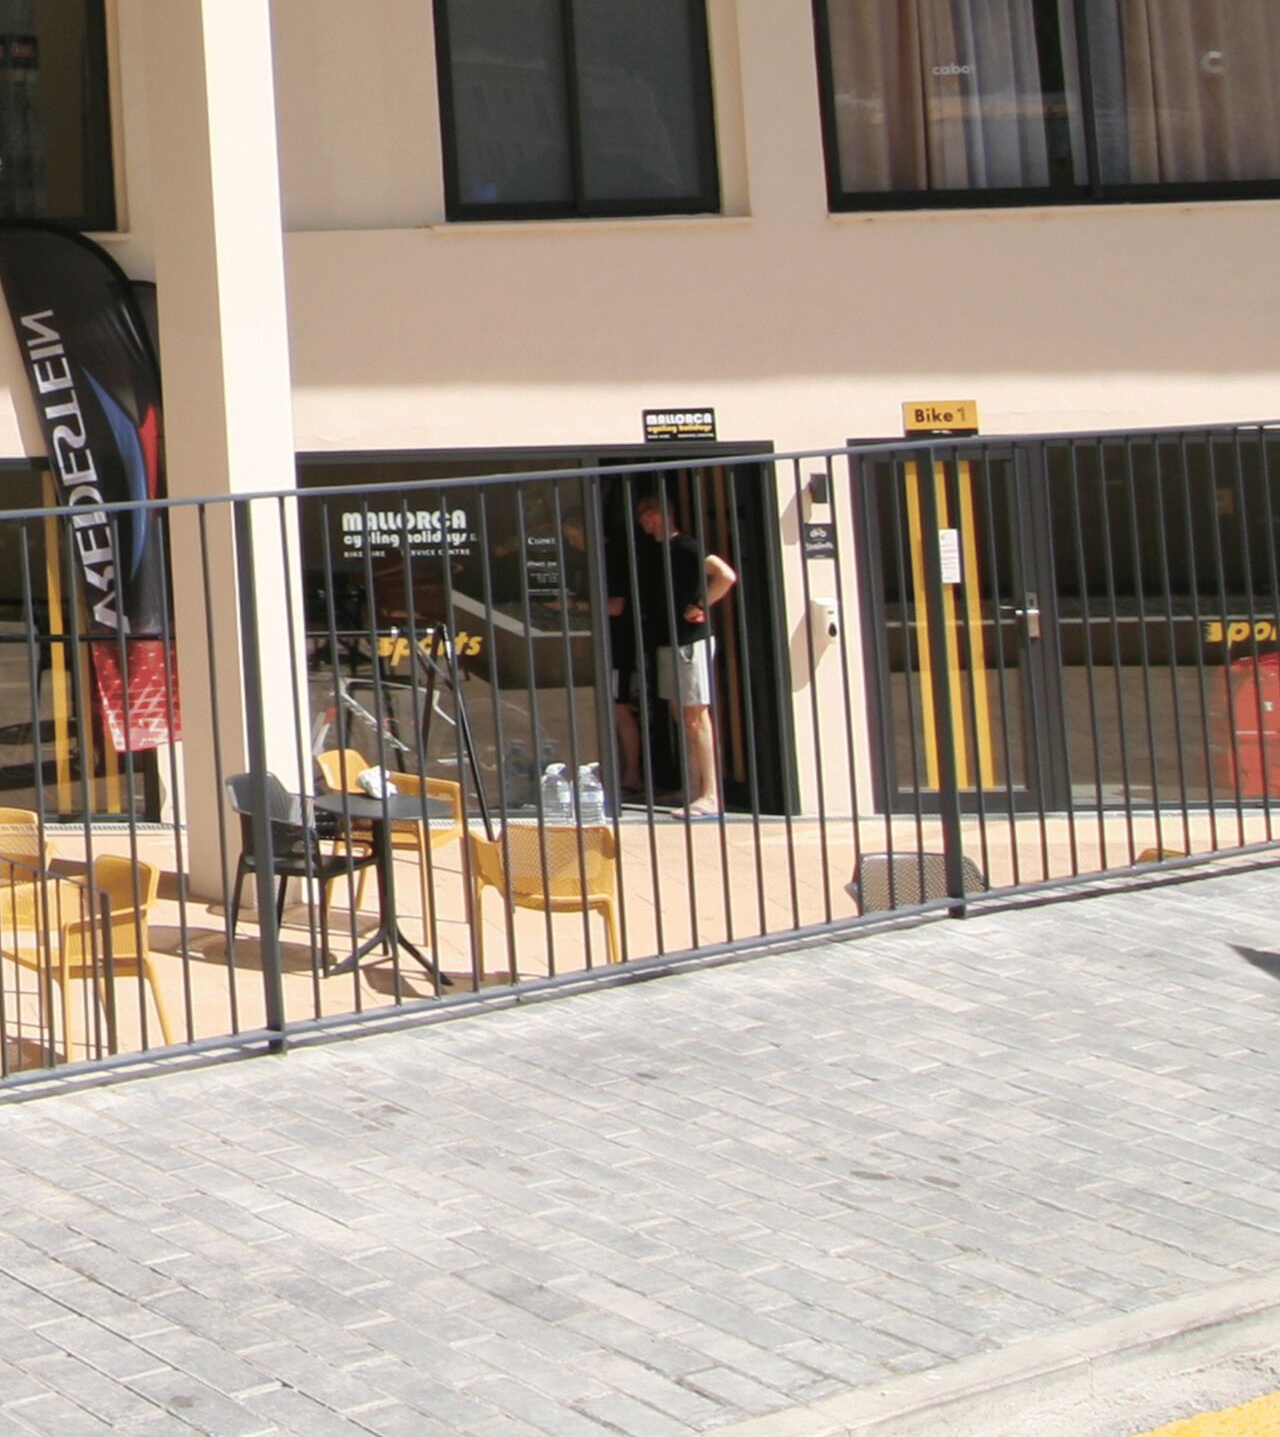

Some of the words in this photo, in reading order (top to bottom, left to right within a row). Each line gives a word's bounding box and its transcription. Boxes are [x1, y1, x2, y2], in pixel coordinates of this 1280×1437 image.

[646, 413, 712, 425] MALLORCA
[914, 407, 954, 423] Bike
[956, 406, 967, 422] 1
[342, 510, 467, 531] MALLORCA
[343, 531, 400, 548] cyling
[403, 531, 467, 546] olidys
